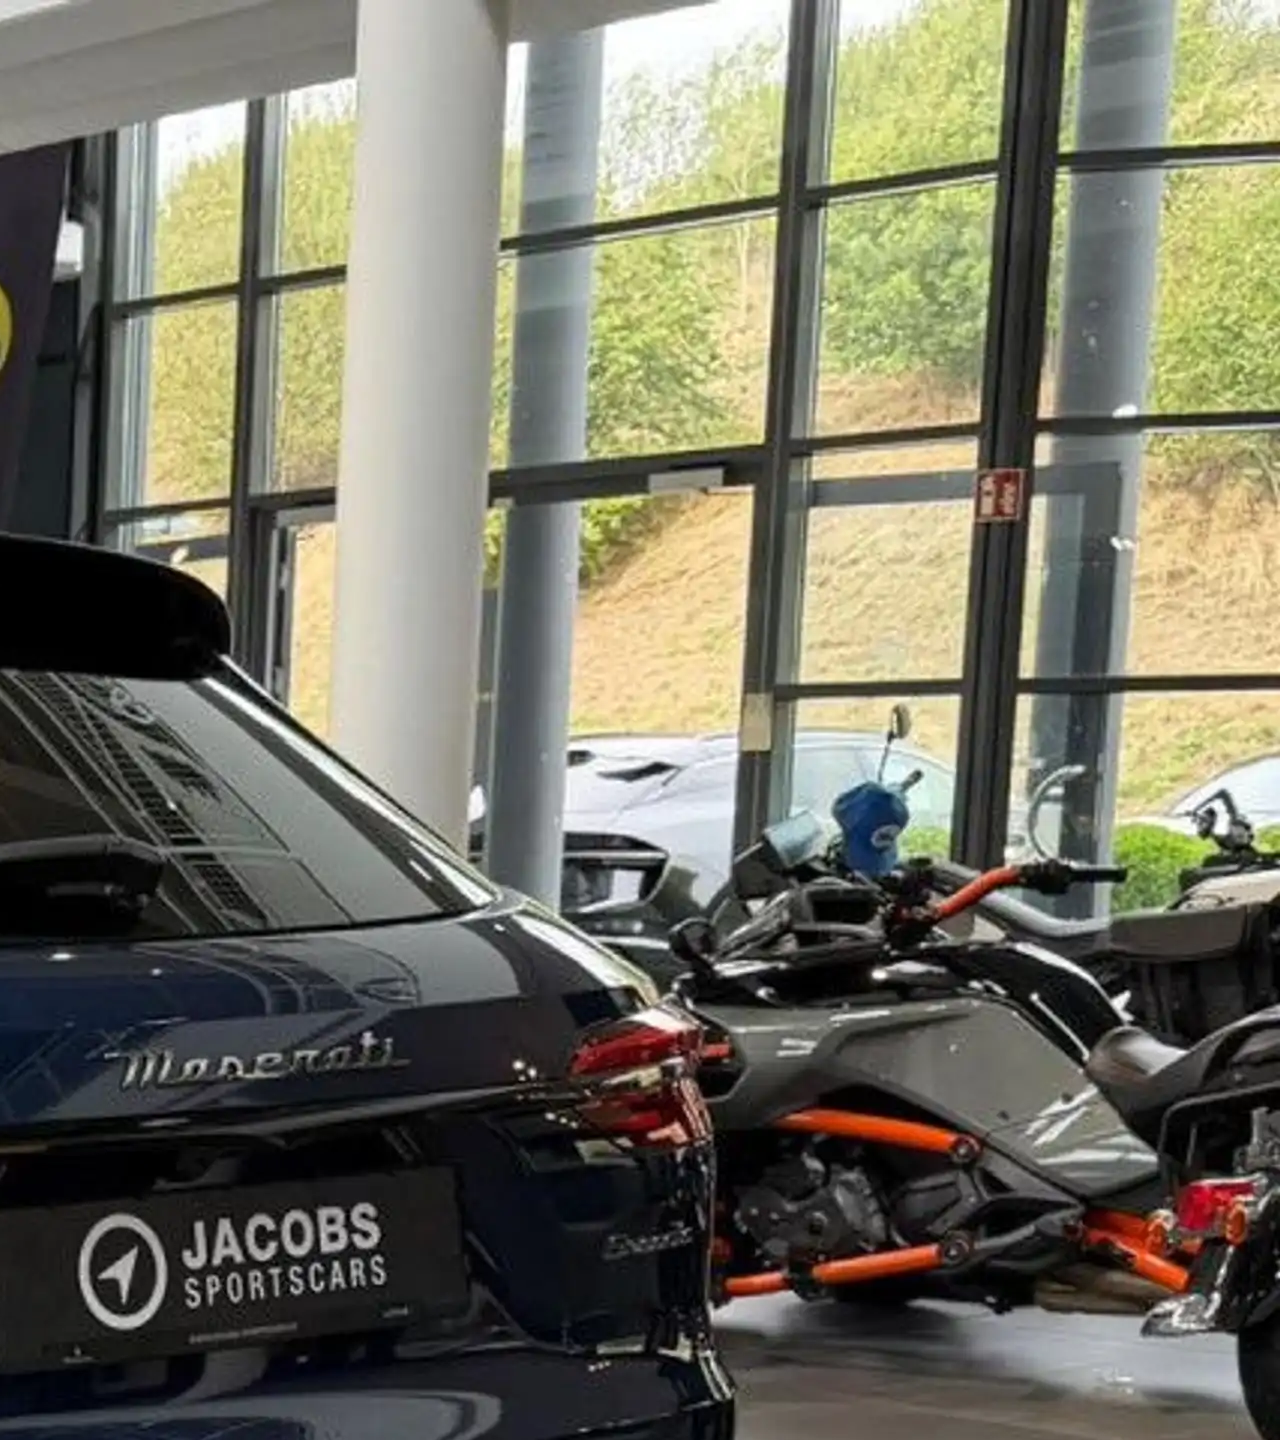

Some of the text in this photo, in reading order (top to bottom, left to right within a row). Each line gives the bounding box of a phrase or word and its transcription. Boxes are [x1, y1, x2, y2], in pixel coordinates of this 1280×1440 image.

[104, 1031, 411, 1088] Maserati
[181, 1202, 382, 1270] JACOBS
[184, 1254, 387, 1309] SPORTSCARS
